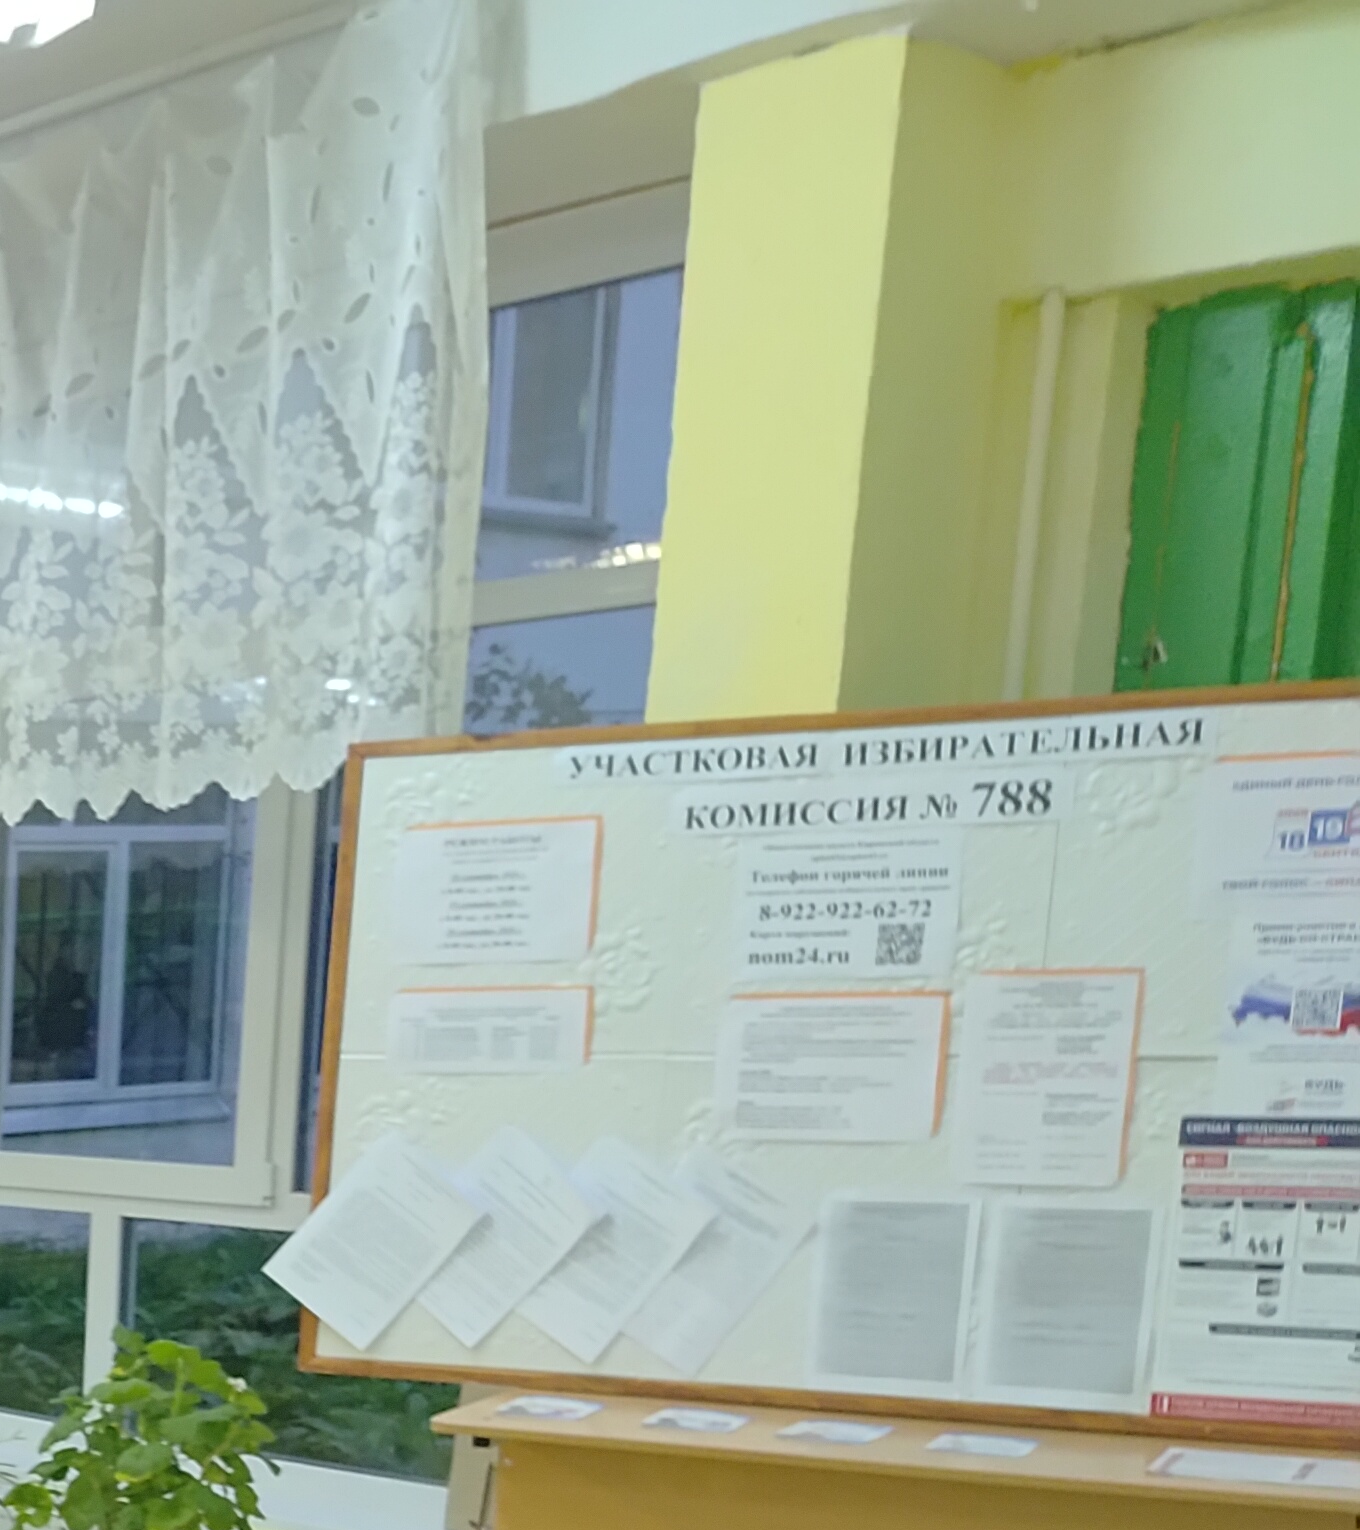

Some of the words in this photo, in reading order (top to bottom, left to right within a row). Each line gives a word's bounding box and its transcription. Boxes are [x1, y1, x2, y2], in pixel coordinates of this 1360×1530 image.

[569, 743, 819, 780] УЧАСТКОВАЯ
[843, 718, 1205, 767] ИЗБИРАТЕЛЬНАЯ
[684, 794, 909, 831] КОМИССИЯ
[919, 793, 958, 822] №
[971, 777, 1055, 818] 788
[751, 869, 820, 885] Телефон
[823, 866, 891, 884] горячей
[896, 866, 950, 879] линии
[758, 898, 933, 922] 8-922-922-62-72
[747, 947, 851, 966] nom24.ru
